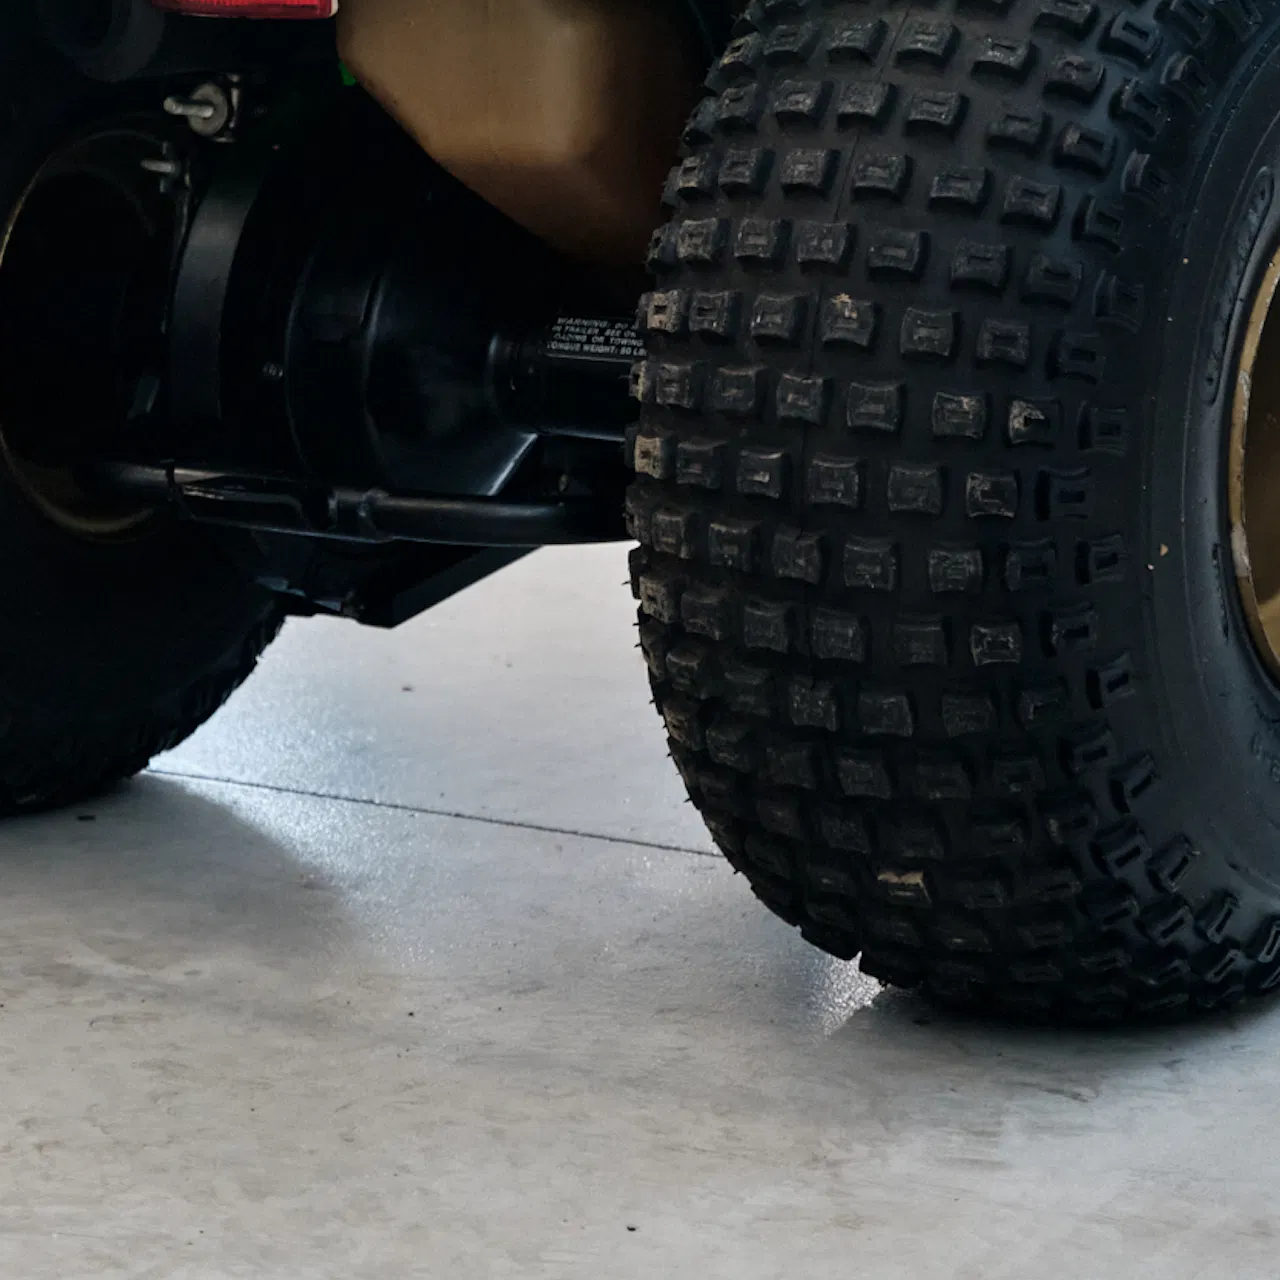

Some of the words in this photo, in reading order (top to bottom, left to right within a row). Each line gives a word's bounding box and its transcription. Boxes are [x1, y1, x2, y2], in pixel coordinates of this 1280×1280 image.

[553, 332, 587, 342] OADING
[591, 335, 605, 343] OR
[610, 337, 644, 347] TOWING
